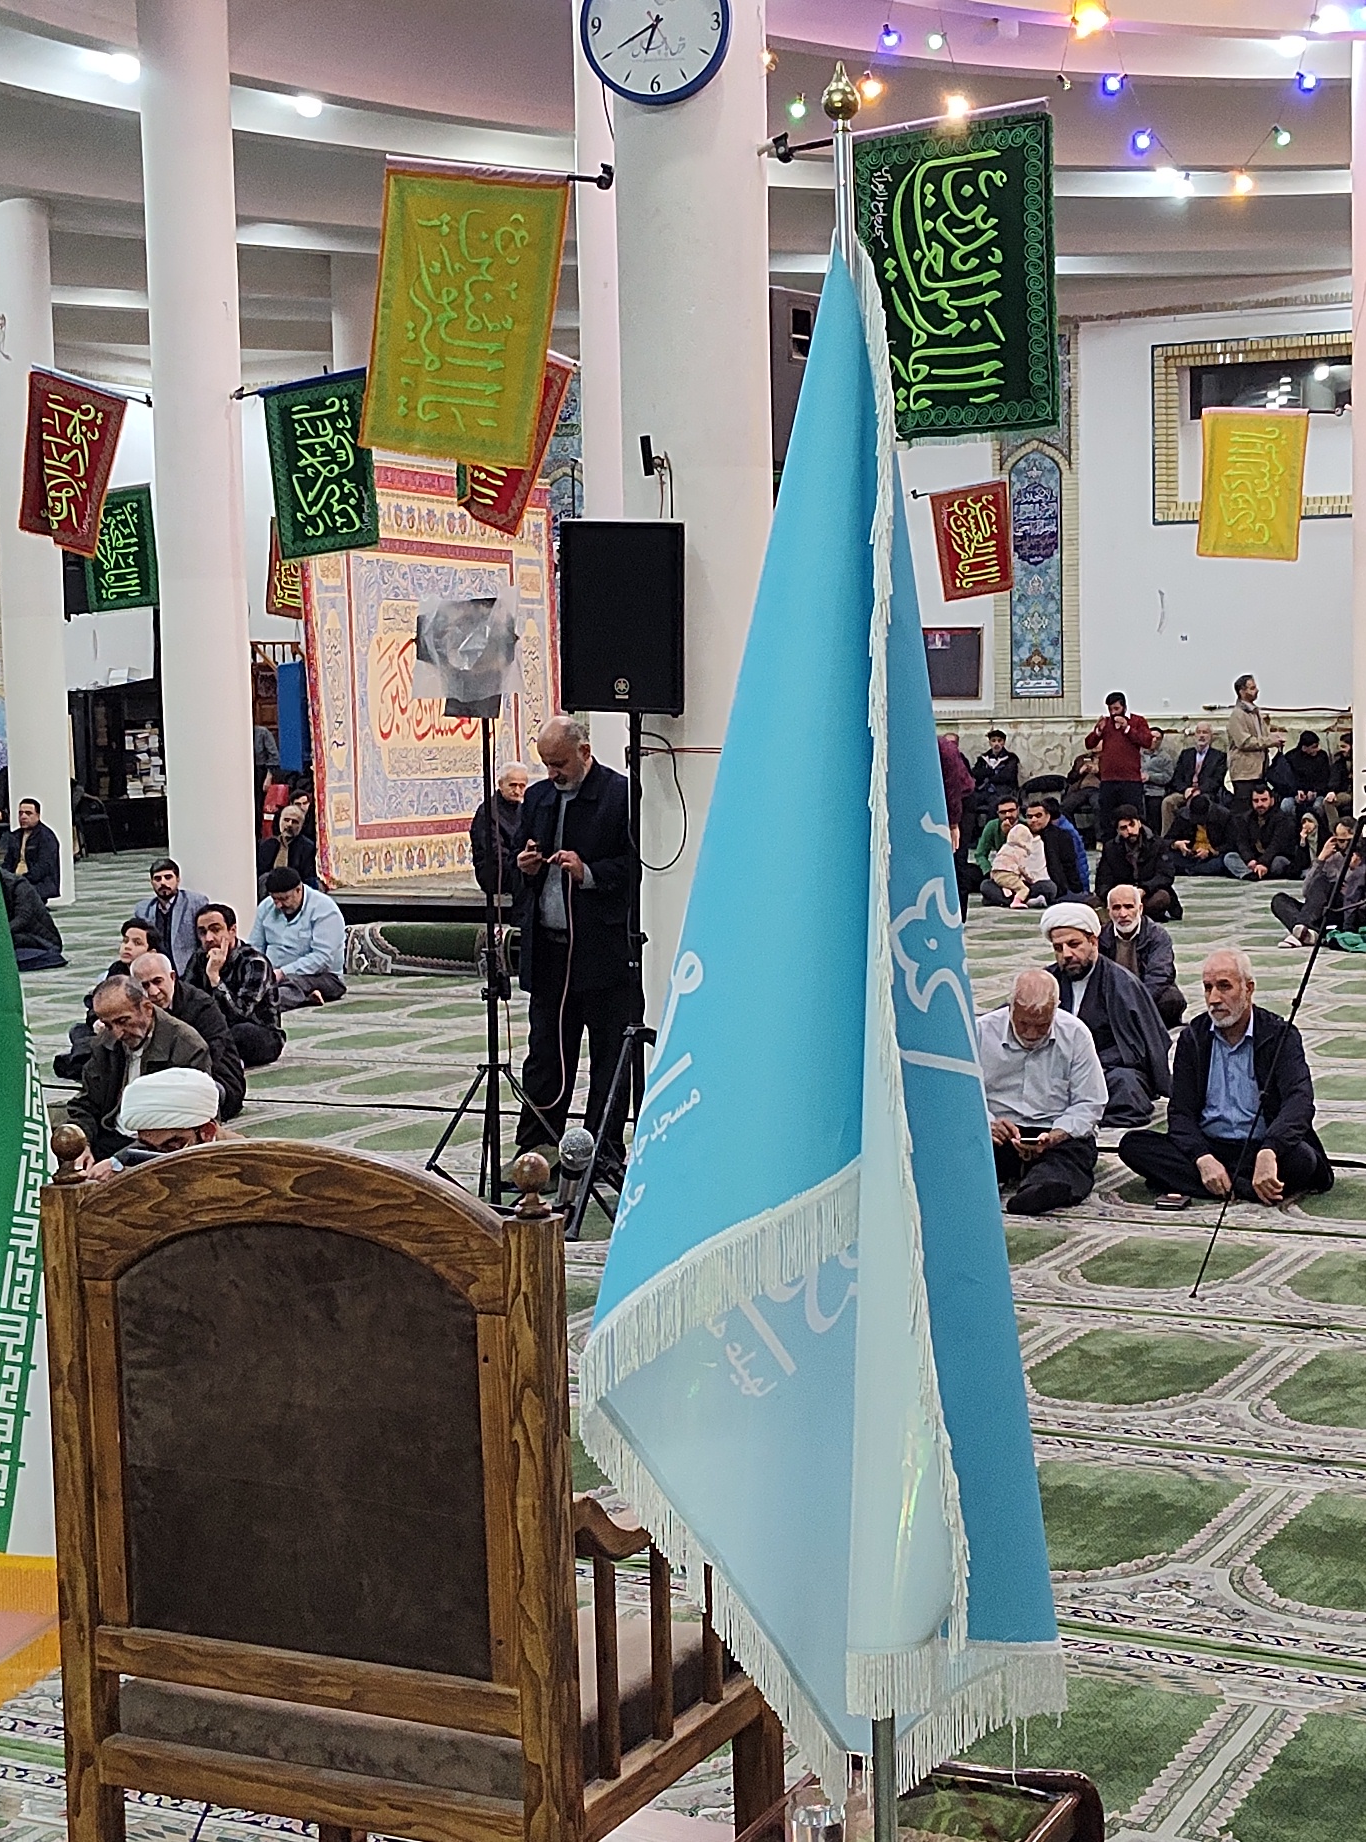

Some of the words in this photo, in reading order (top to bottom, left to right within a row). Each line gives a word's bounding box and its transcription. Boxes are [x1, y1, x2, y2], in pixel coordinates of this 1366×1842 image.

[590, 17, 602, 36] 9
[710, 11, 721, 31] 3
[650, 74, 662, 93] 6
